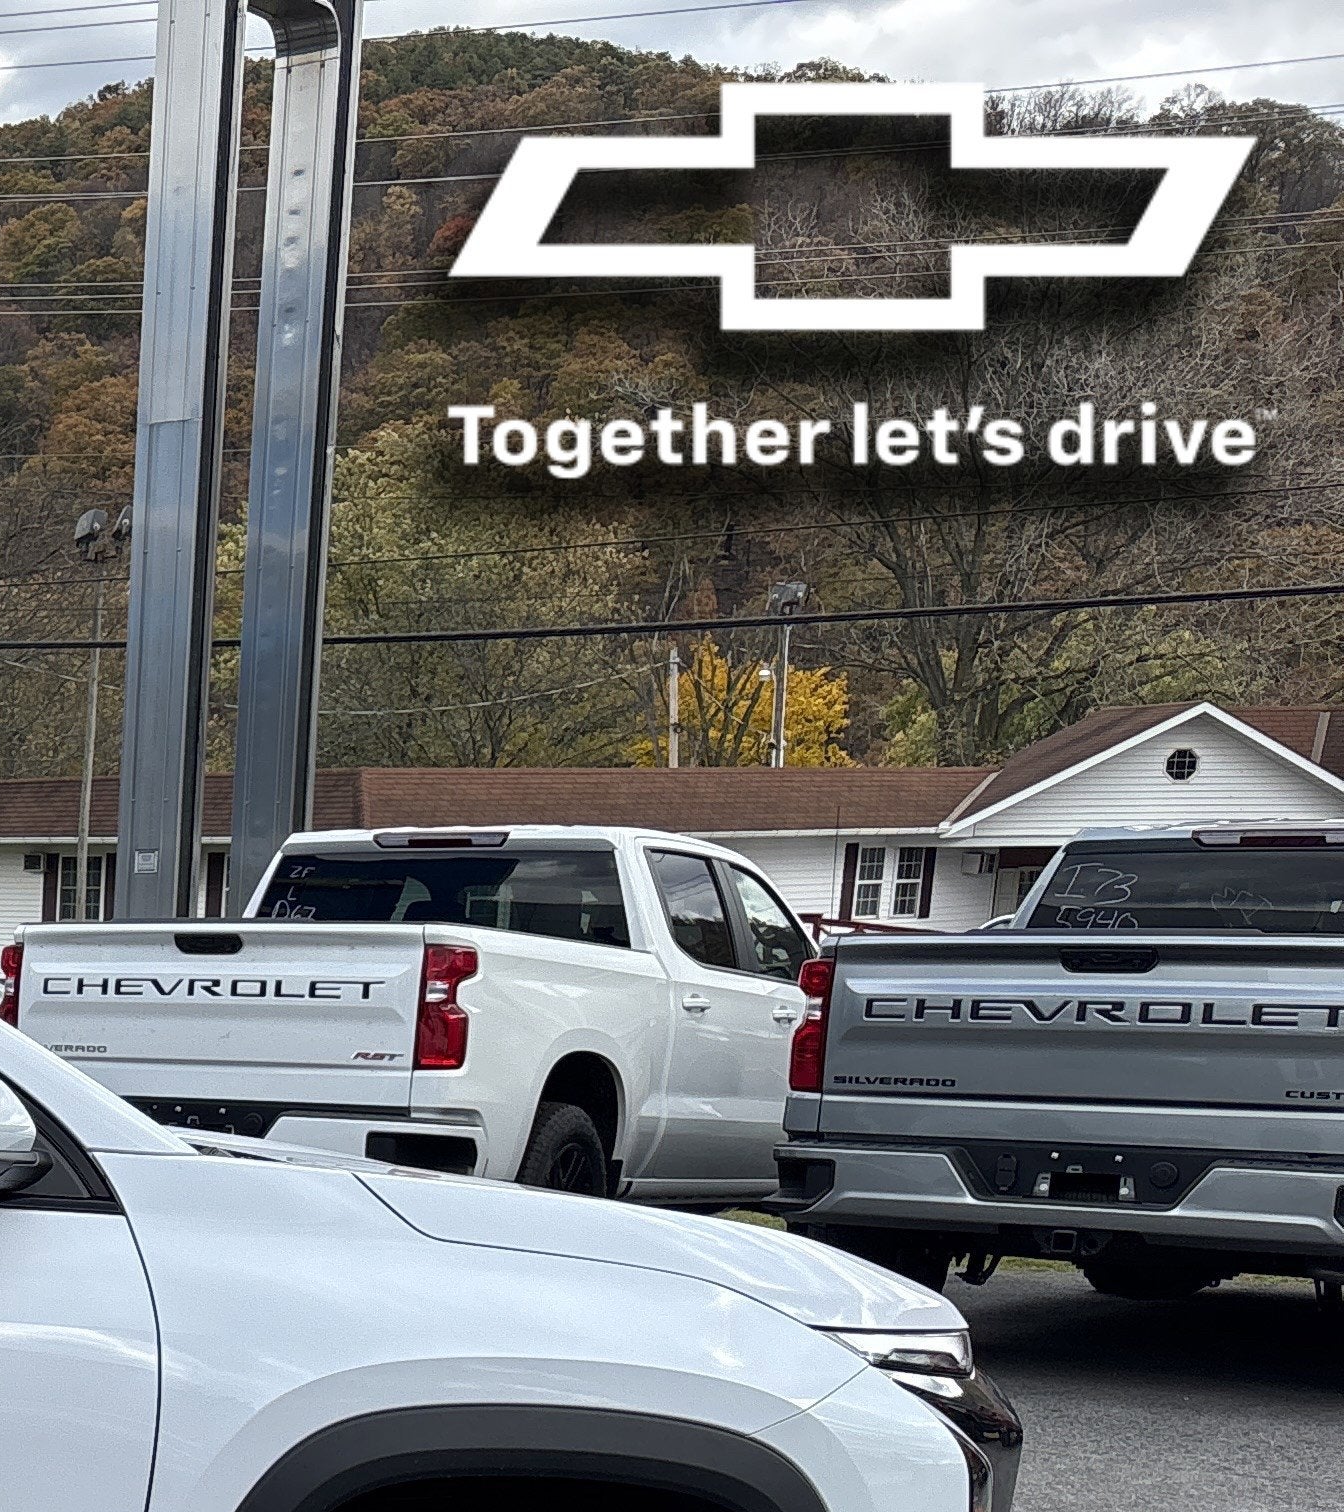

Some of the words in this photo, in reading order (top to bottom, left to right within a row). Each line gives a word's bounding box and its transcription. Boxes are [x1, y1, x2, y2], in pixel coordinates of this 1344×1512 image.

[42, 976, 387, 1000] CHEVROLET
[863, 997, 1344, 1030] CHEVROLET
[350, 1051, 405, 1062] RST
[833, 1075, 957, 1088] SILVERADO
